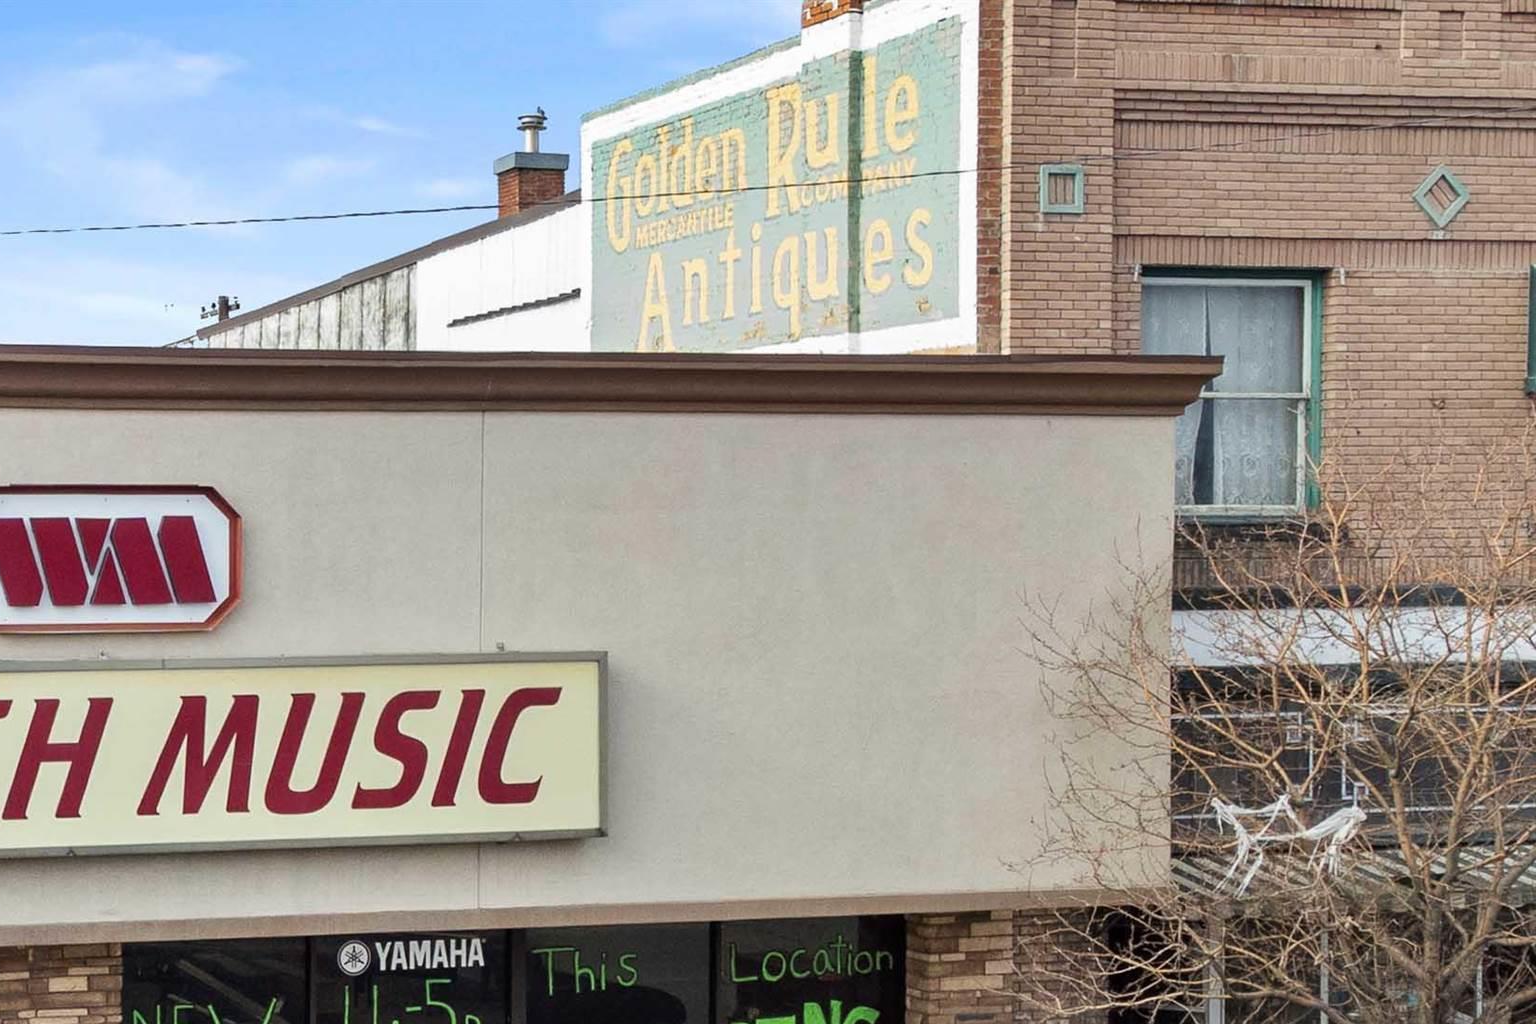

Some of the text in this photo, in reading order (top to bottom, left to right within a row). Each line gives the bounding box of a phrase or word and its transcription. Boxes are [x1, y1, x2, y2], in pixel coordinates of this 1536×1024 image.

[607, 56, 919, 253] Golden Rule
[635, 203, 734, 248] MERCANTILE
[636, 206, 934, 352] Antiques
[136, 687, 563, 815] MUSIC
[375, 938, 486, 971] YAMAHA
[531, 935, 893, 996] This Location
